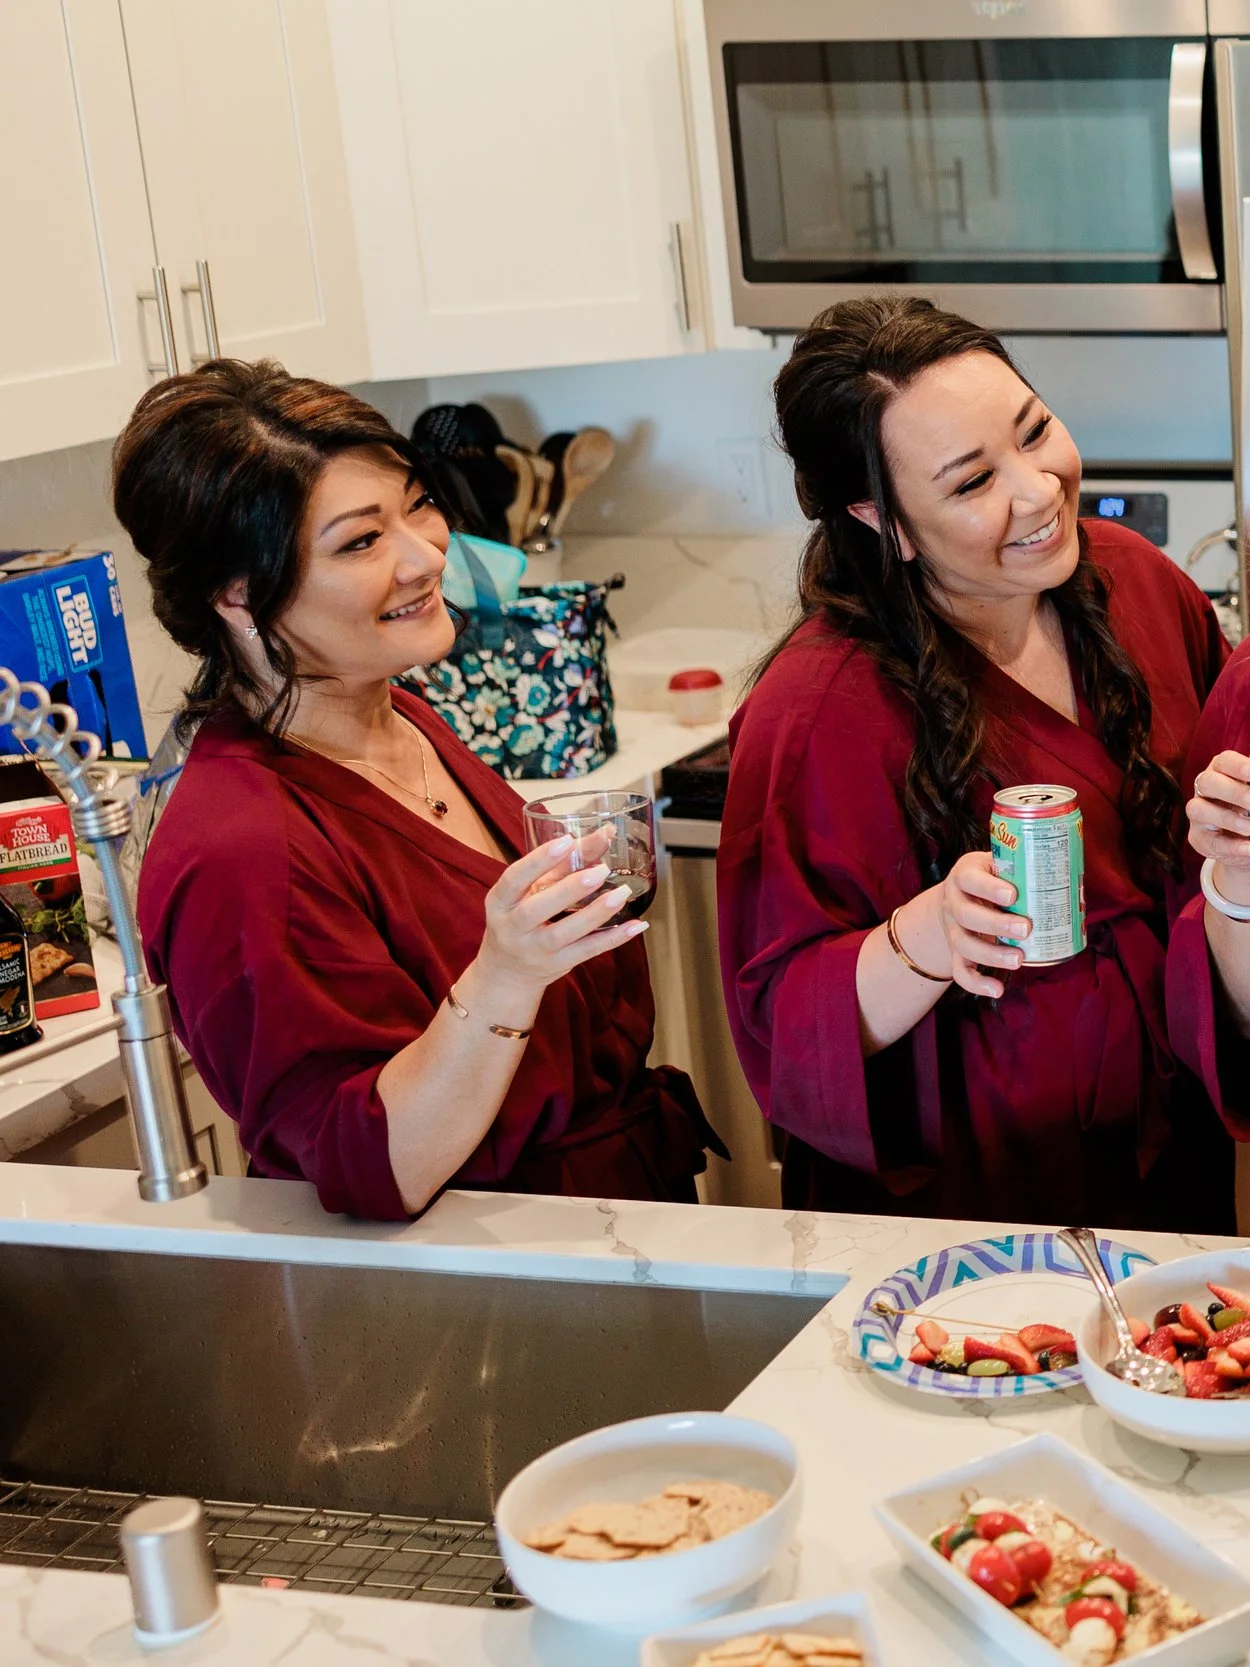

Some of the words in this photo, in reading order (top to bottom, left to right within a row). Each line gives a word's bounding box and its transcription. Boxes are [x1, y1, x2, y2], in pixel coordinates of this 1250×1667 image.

[56, 585, 88, 664] LIGHT
[73, 592, 97, 650] BUD
[11, 824, 47, 838] TOWN
[12, 833, 51, 848] HOUSE
[998, 821, 1017, 850] Sun
[0, 843, 68, 863] FLATBREAD
